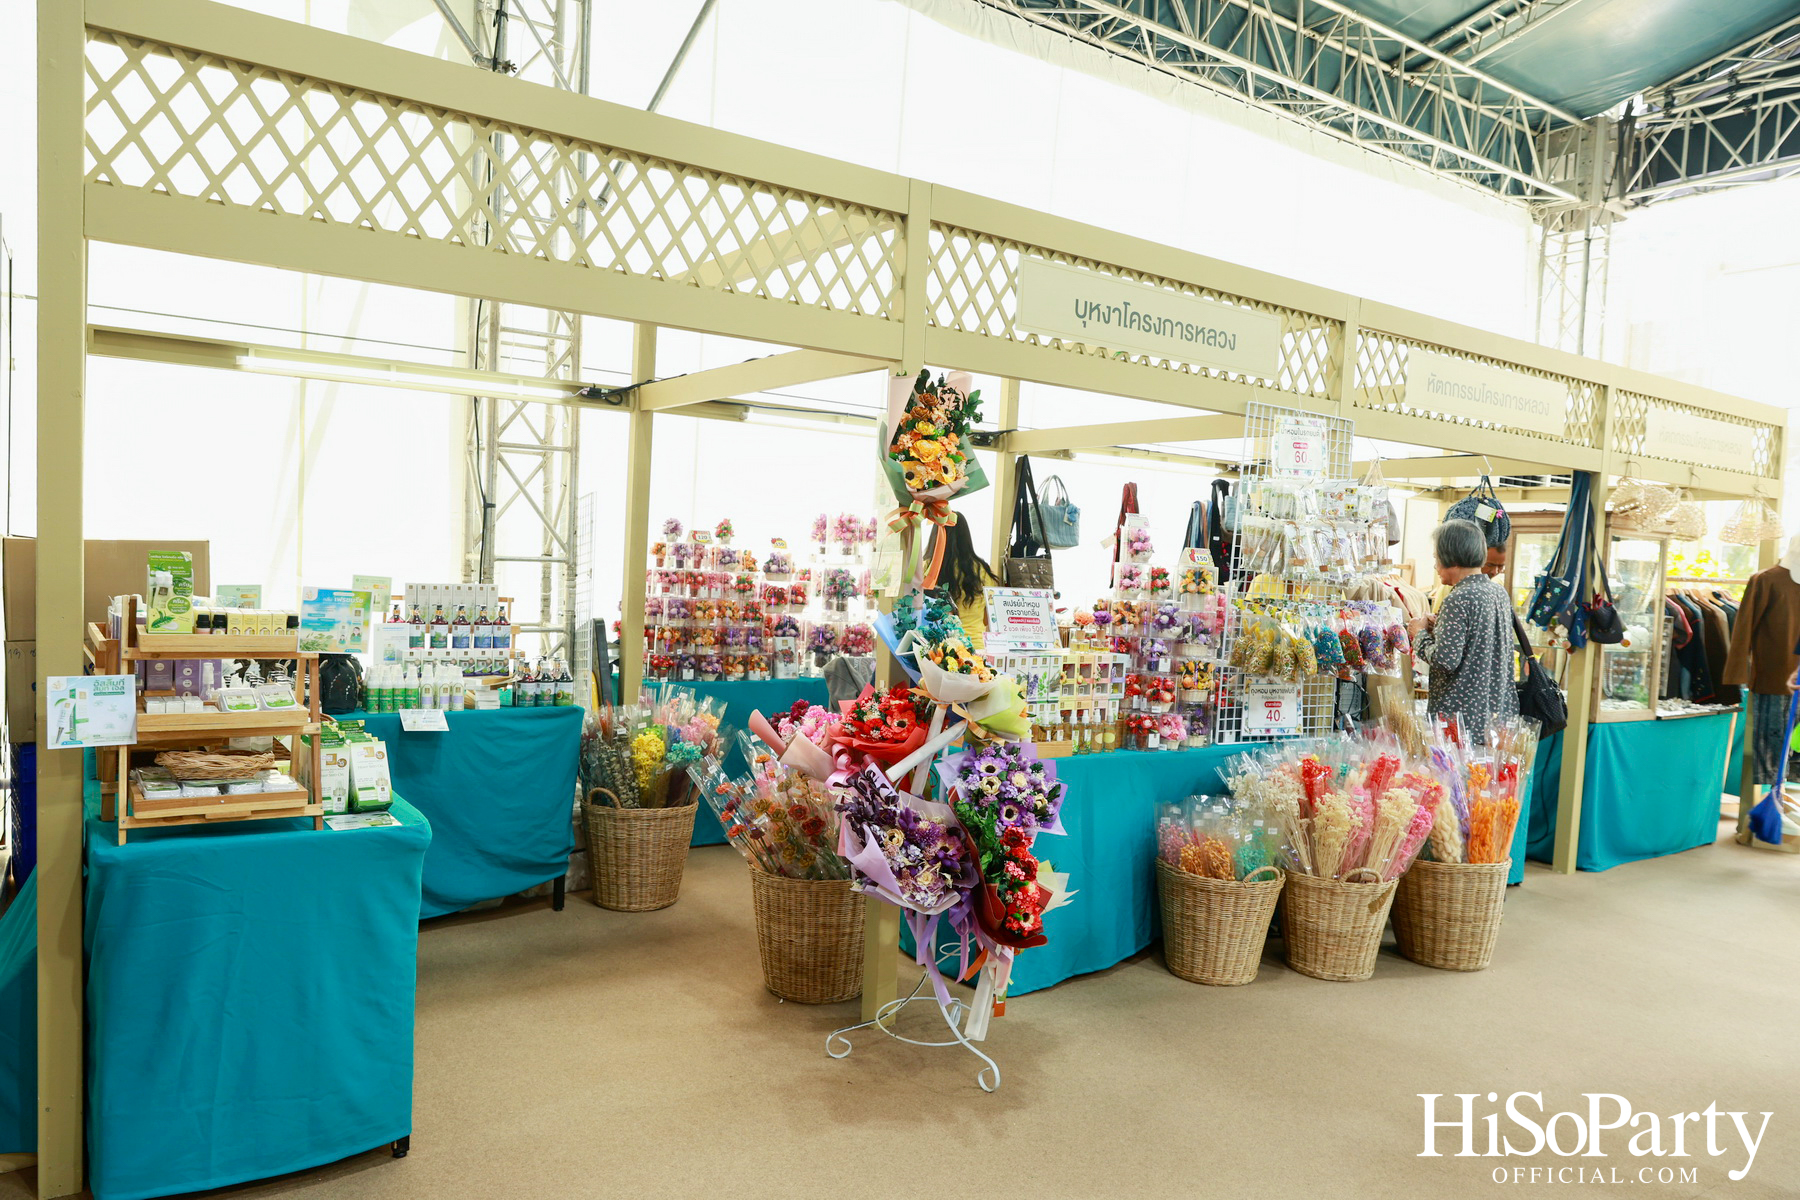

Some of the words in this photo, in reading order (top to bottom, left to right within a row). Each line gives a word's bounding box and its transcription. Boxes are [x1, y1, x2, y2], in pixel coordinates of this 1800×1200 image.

[1074, 298, 1237, 351] บุหงาโครงการหลวง
[1426, 371, 1550, 417] หัตถกรรมโครงการหลวง
